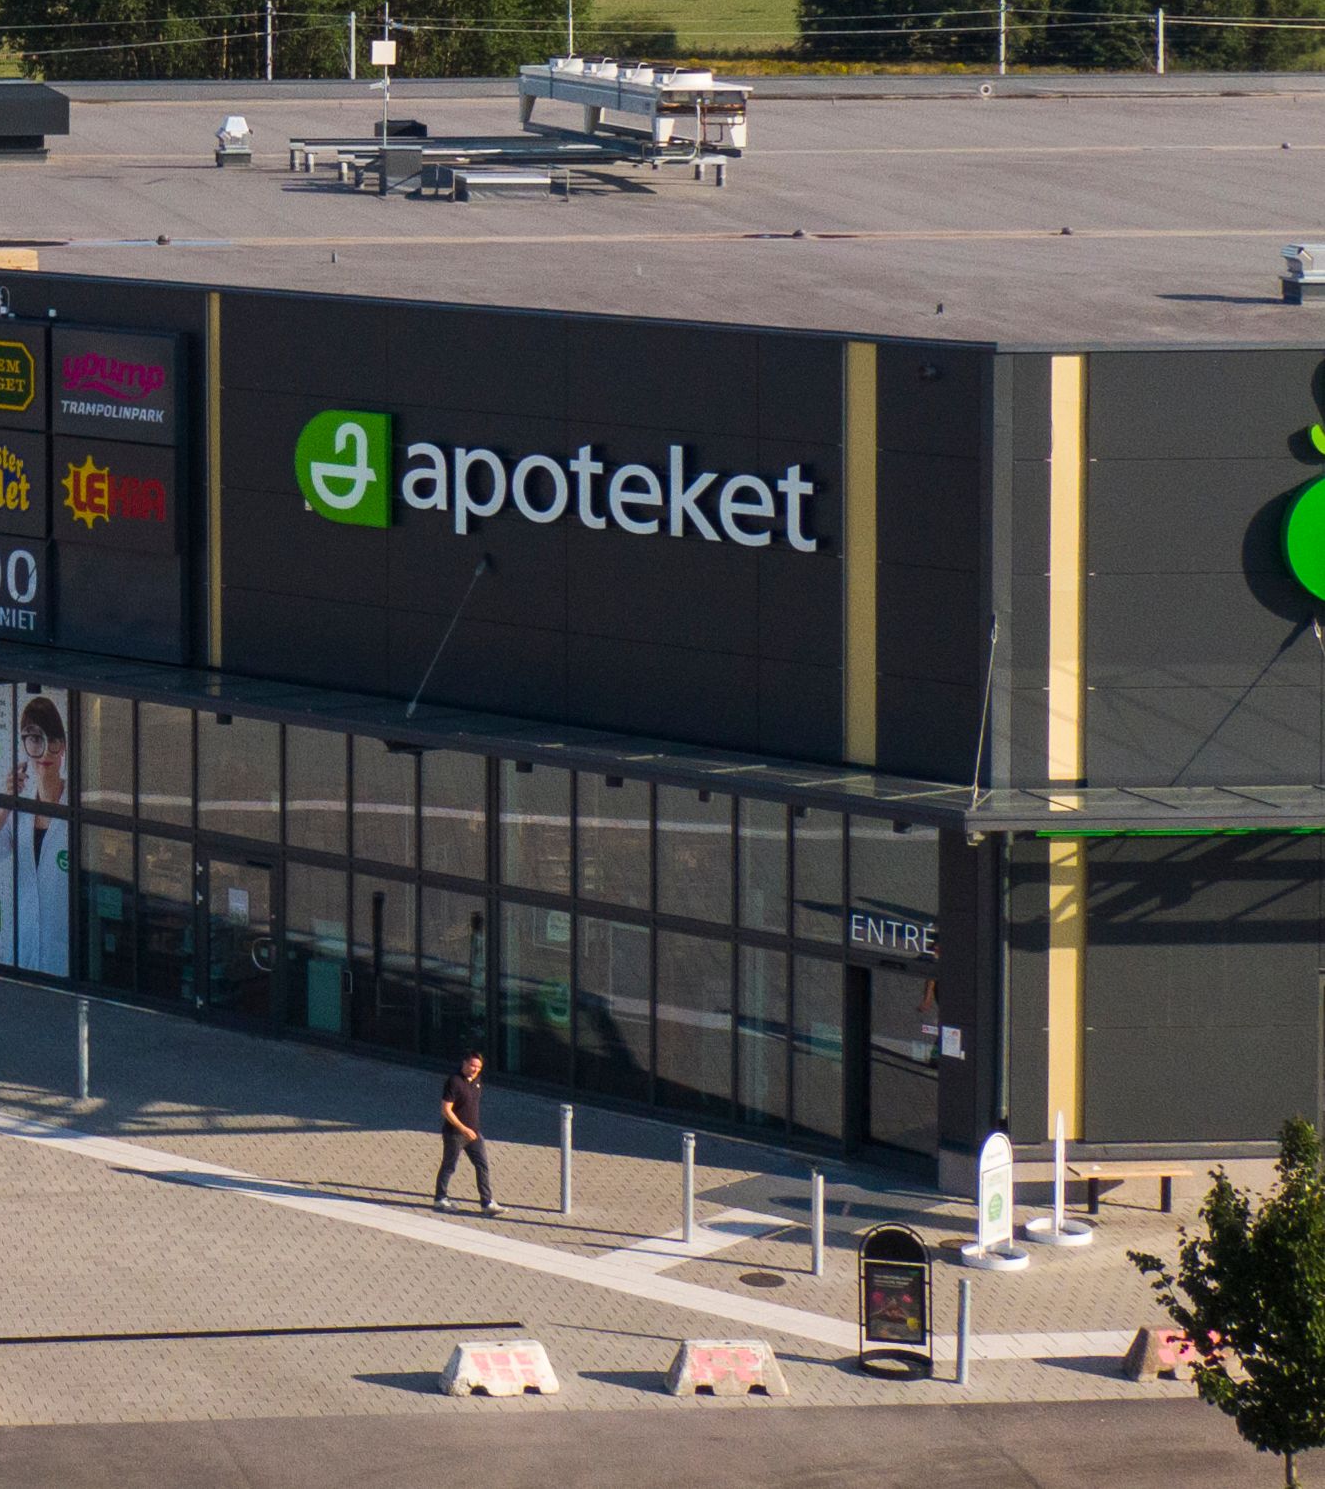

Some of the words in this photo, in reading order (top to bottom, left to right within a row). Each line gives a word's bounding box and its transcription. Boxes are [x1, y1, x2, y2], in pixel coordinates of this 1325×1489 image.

[60, 399, 165, 424] TRAMPOLINPARK
[401, 442, 818, 553] apoteket
[851, 914, 936, 954] ENTRÉ
